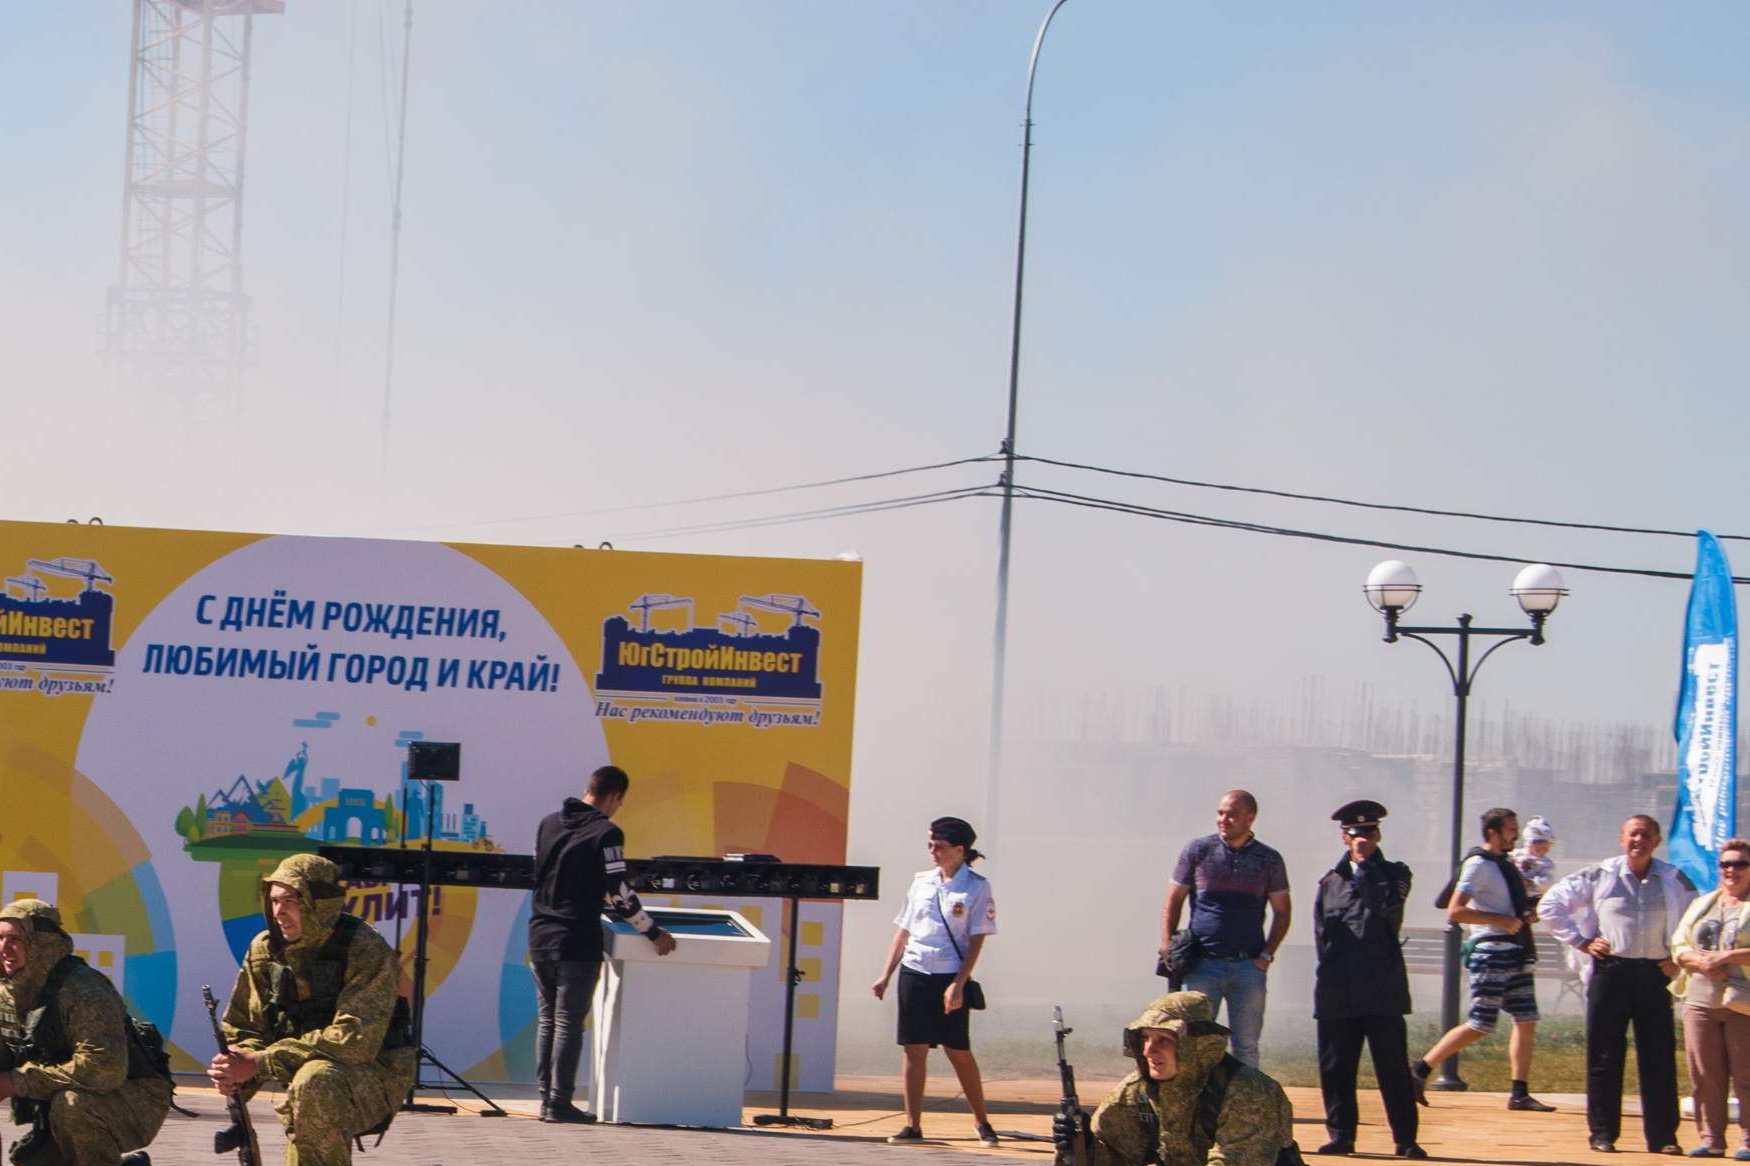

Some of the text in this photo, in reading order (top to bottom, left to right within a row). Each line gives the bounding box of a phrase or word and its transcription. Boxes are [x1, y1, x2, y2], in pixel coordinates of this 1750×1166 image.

[196, 590, 507, 642] С ДНЁМ РОЖДЕНИЯ,
[143, 643, 561, 692] ЛЮБИМЫЙ ГОРОД И КРАЙ!
[618, 641, 802, 673] ЮгСтройИнвест
[38, 675, 115, 695] друзьям!
[662, 674, 756, 688] ГРУППА КОМПАНИЙ
[595, 702, 821, 728] Нас рекомендуют друзьям!
